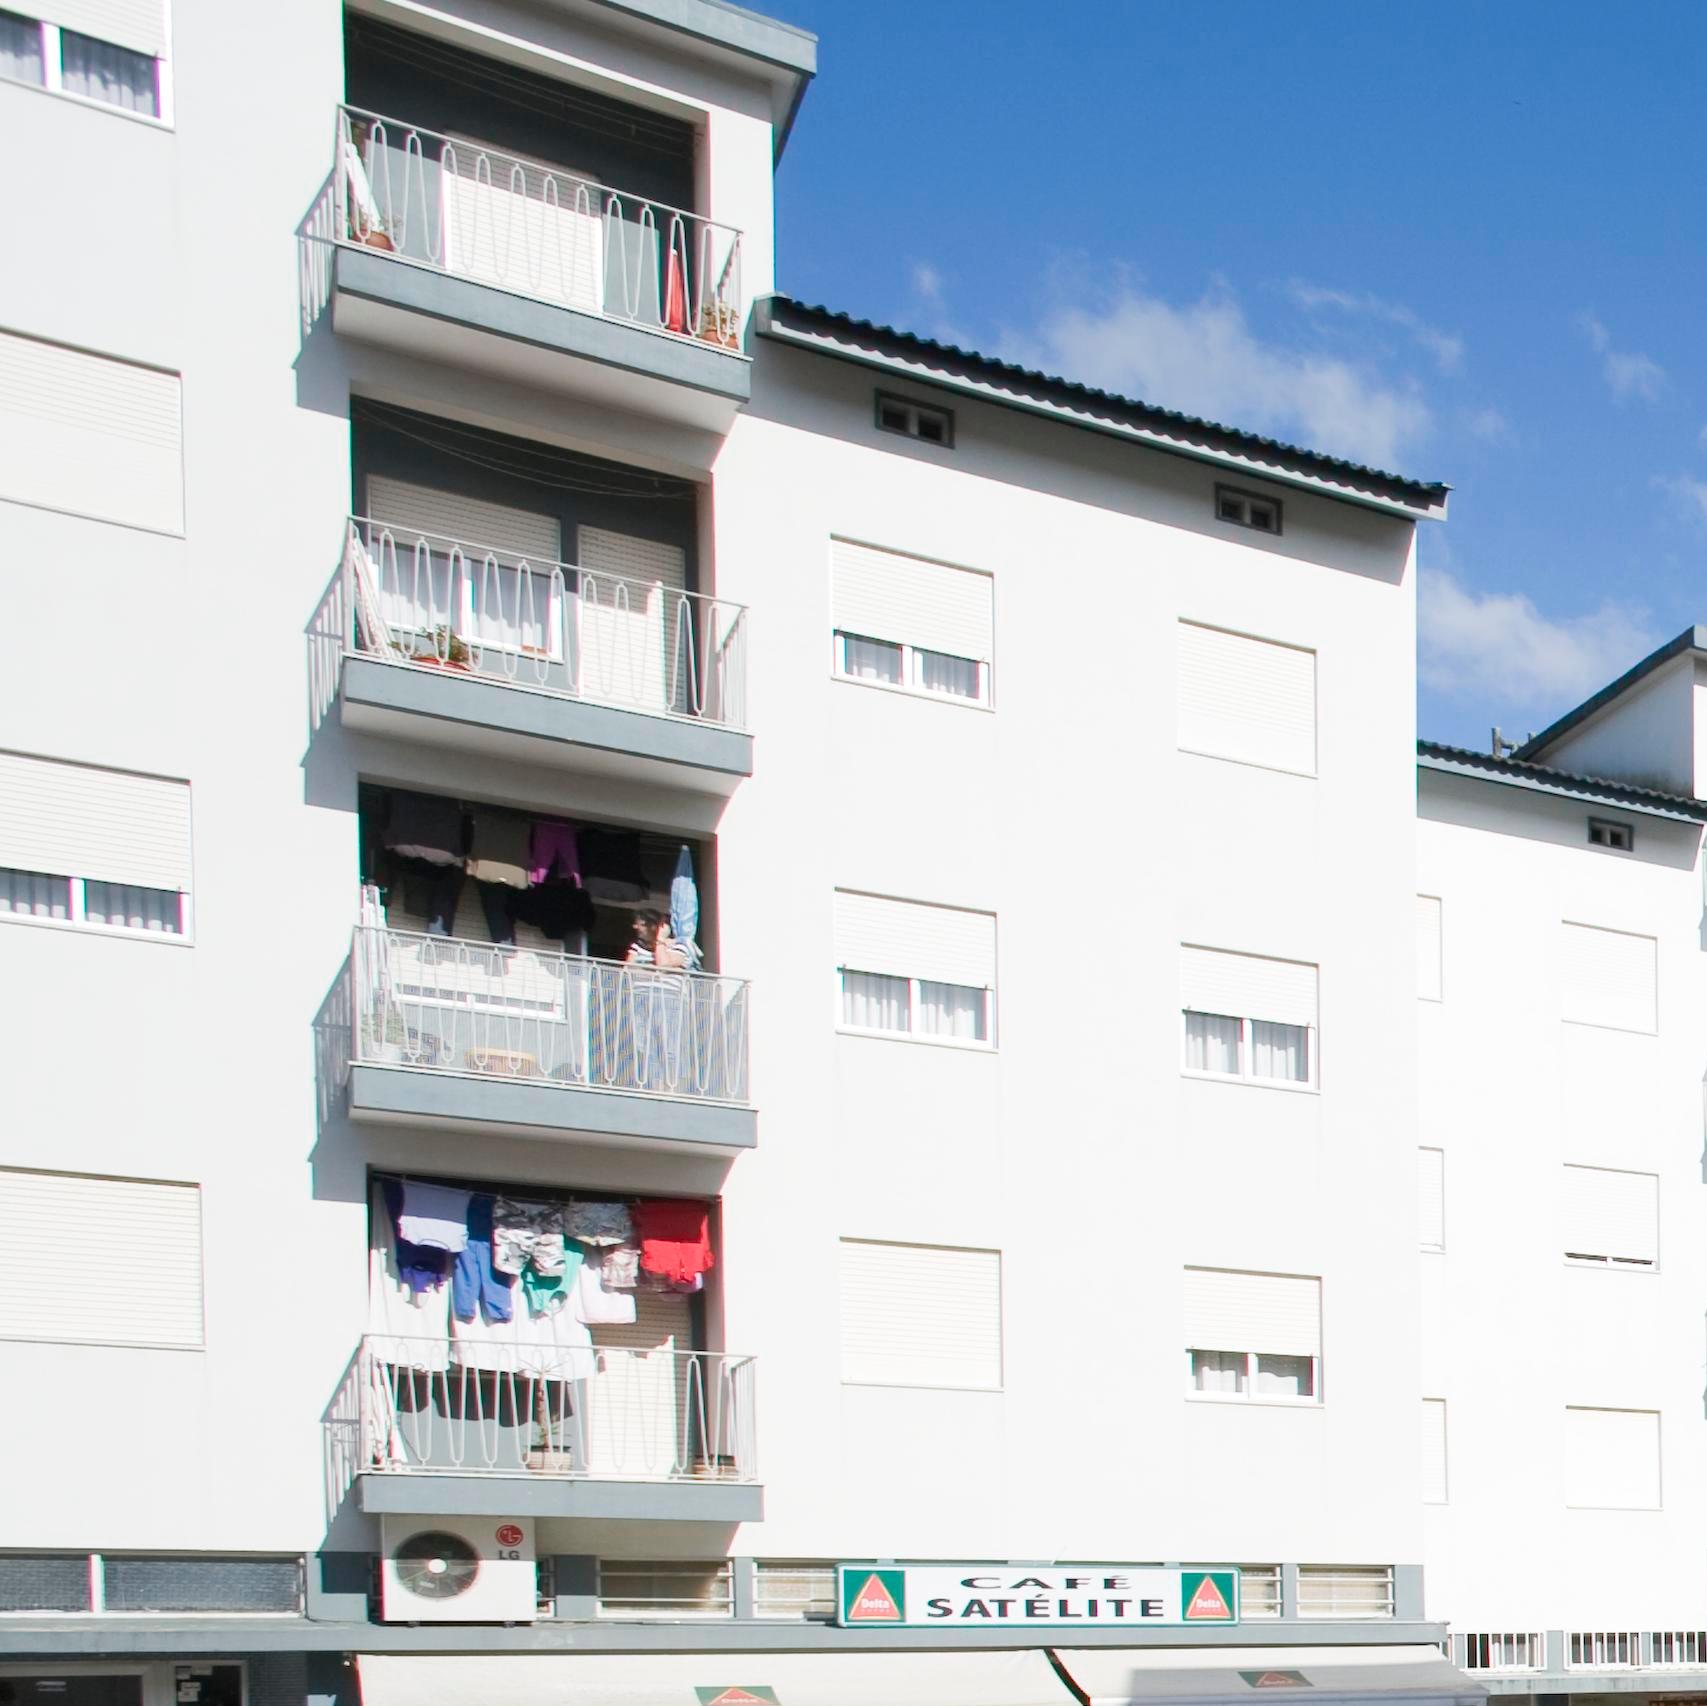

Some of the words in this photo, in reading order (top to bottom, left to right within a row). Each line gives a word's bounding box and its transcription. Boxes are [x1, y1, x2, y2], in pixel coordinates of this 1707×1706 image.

[498, 1550, 520, 1560] LG
[961, 1575, 1132, 1590] CAFÉ
[861, 1597, 890, 1609] Delta
[927, 1593, 1165, 1618] SATÉLITE
